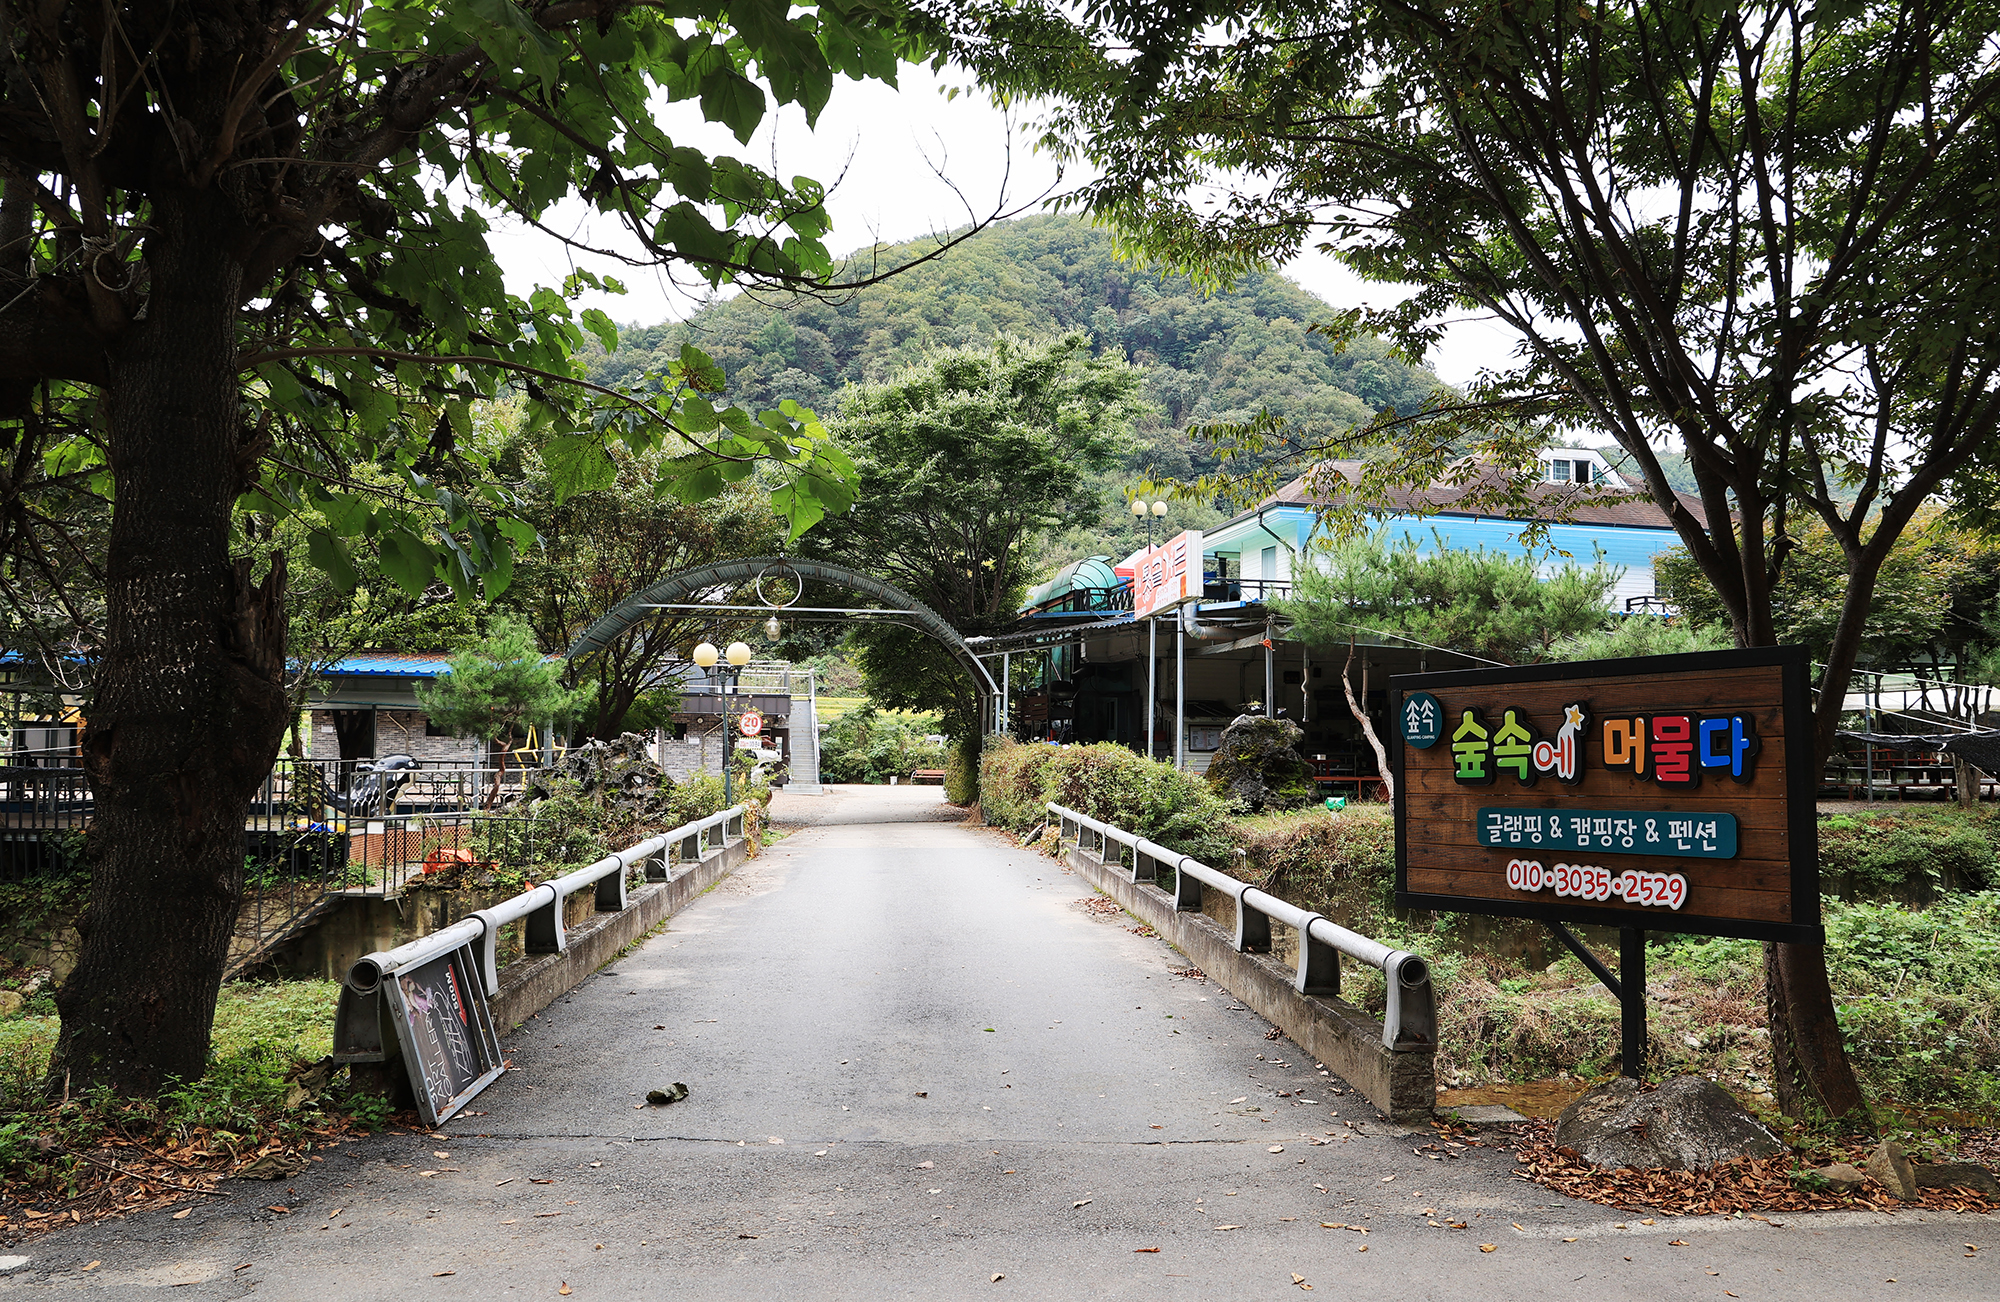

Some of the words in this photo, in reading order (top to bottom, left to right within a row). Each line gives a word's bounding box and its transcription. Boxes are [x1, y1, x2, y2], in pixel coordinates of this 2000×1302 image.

[744, 717, 758, 728] 20
[1451, 704, 1585, 781] 숲속에
[1602, 711, 1751, 783] 머물다
[1486, 813, 1542, 845] 글램핑
[1549, 815, 1563, 839] &
[1570, 816, 1637, 848] 캠핑장
[1645, 818, 1661, 843] &
[1668, 819, 1718, 852] 펜션
[445, 972, 459, 1009] 500M
[422, 1010, 453, 1096] GALLERY
[427, 1059, 447, 1098] ART
